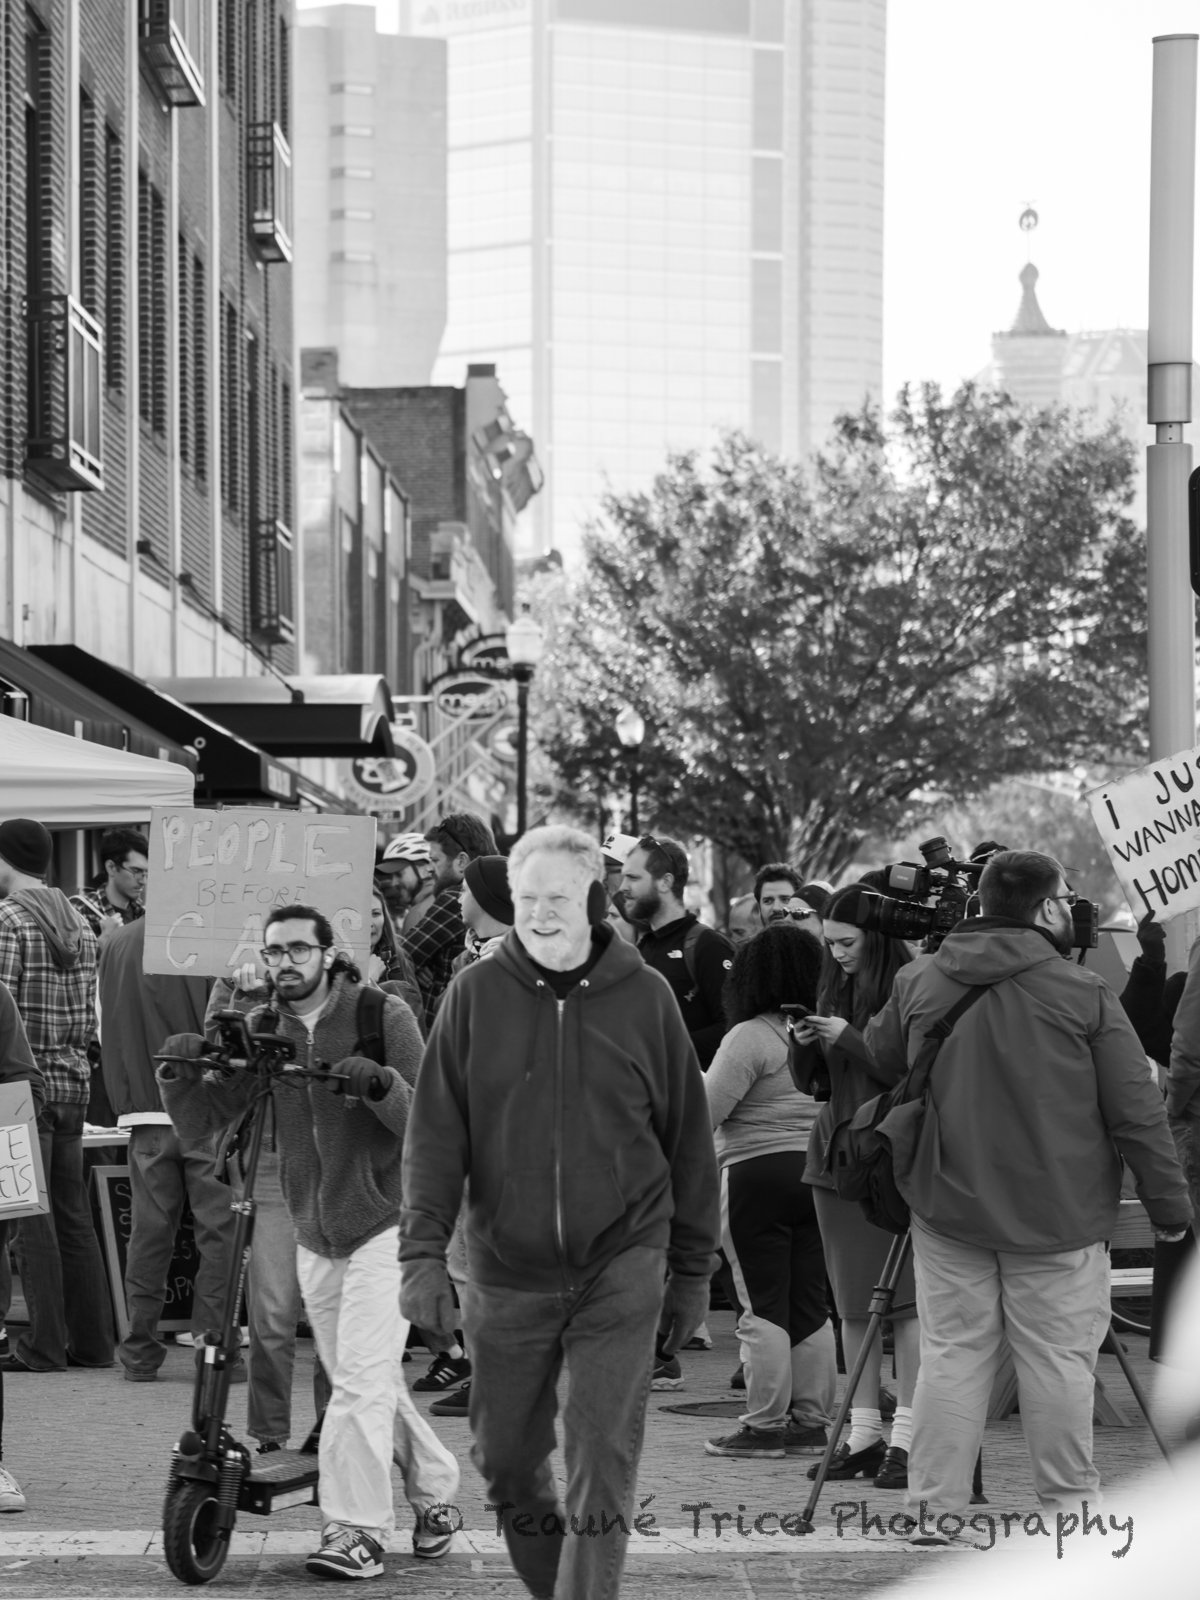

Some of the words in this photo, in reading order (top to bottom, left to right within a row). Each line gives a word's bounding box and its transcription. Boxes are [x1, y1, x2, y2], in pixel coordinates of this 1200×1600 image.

[161, 815, 353, 877] PEOPLE
[196, 878, 306, 907] BEFORE
[1133, 848, 1200, 914] HOM
[166, 907, 362, 969] CAS
